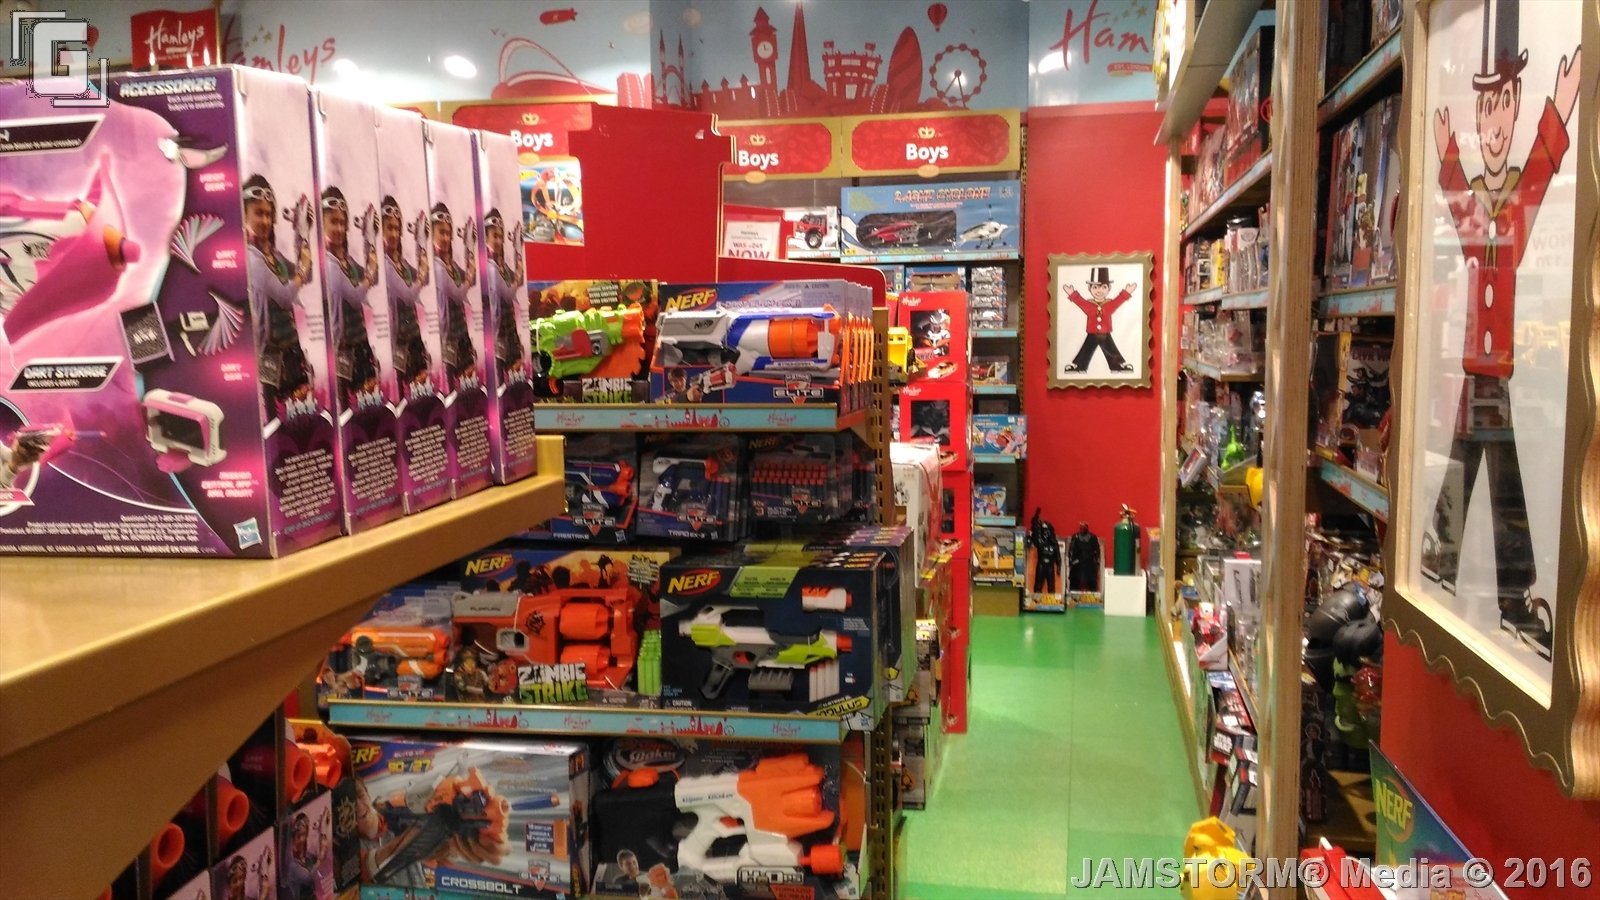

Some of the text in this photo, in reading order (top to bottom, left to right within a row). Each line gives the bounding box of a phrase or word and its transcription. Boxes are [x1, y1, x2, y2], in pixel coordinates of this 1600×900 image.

[144, 17, 205, 54] Hamleys
[119, 77, 217, 98] ACCESSORIZE!
[510, 129, 553, 151] Boys
[738, 150, 779, 170] Boys
[906, 143, 949, 163] Boys
[728, 249, 770, 259] NOW
[665, 288, 716, 311] NERF
[24, 365, 108, 379] DART STORAGE
[582, 378, 632, 392] ZOMBIE
[775, 388, 822, 397] ELITE
[583, 391, 632, 403] STRIKE
[465, 554, 513, 577] NERF
[668, 571, 720, 594] NERF
[518, 663, 586, 685] ZOMBIE
[388, 687, 432, 698] ELITE
[519, 681, 590, 704] STRIKE
[351, 745, 380, 764] ERF
[1375, 778, 1413, 830] NERF
[441, 876, 522, 895] CROSSBOLT
